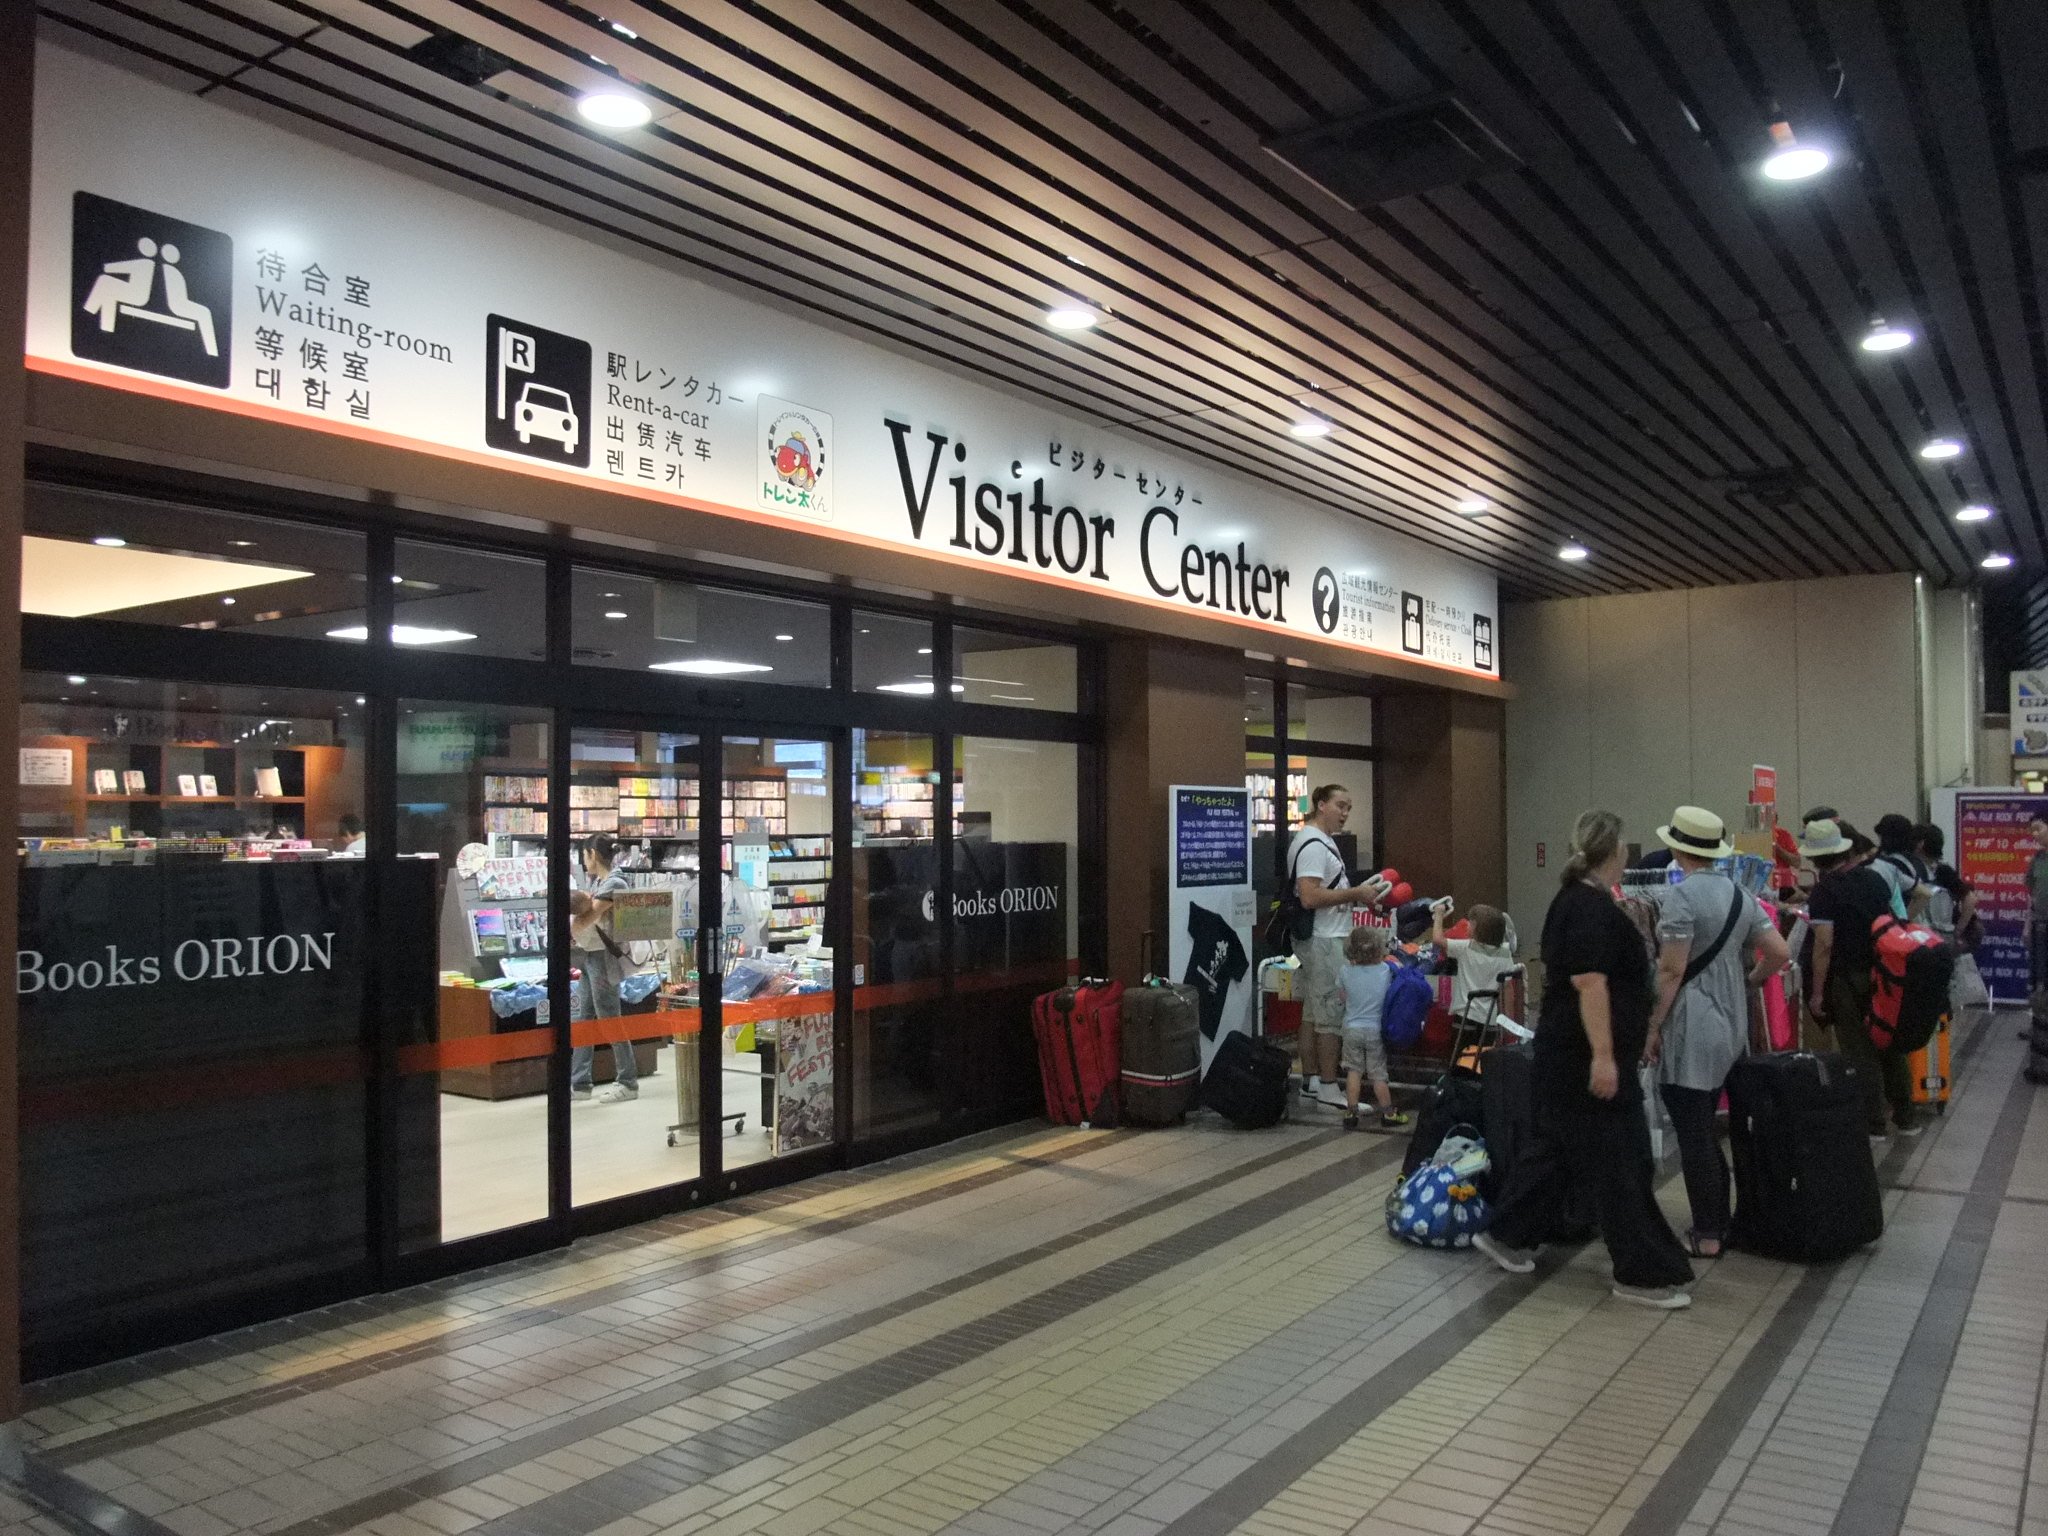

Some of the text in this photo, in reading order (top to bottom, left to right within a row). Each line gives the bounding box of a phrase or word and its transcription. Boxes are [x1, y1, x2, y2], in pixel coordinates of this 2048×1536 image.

[256, 248, 370, 308] 待合室
[255, 285, 453, 364] Waiting-room
[255, 325, 369, 383] 等候室
[606, 351, 744, 406] 駅レンタカー
[255, 367, 370, 420] 대합실
[606, 383, 709, 430] Rent-a-car
[606, 449, 685, 490] 렌트카
[763, 481, 828, 513] トレン太くん
[1048, 442, 1204, 506] ビジターセンター
[884, 417, 1290, 623] Visitor Center
[1000, 886, 1059, 914] ORION
[16, 932, 336, 994] Books ORION
